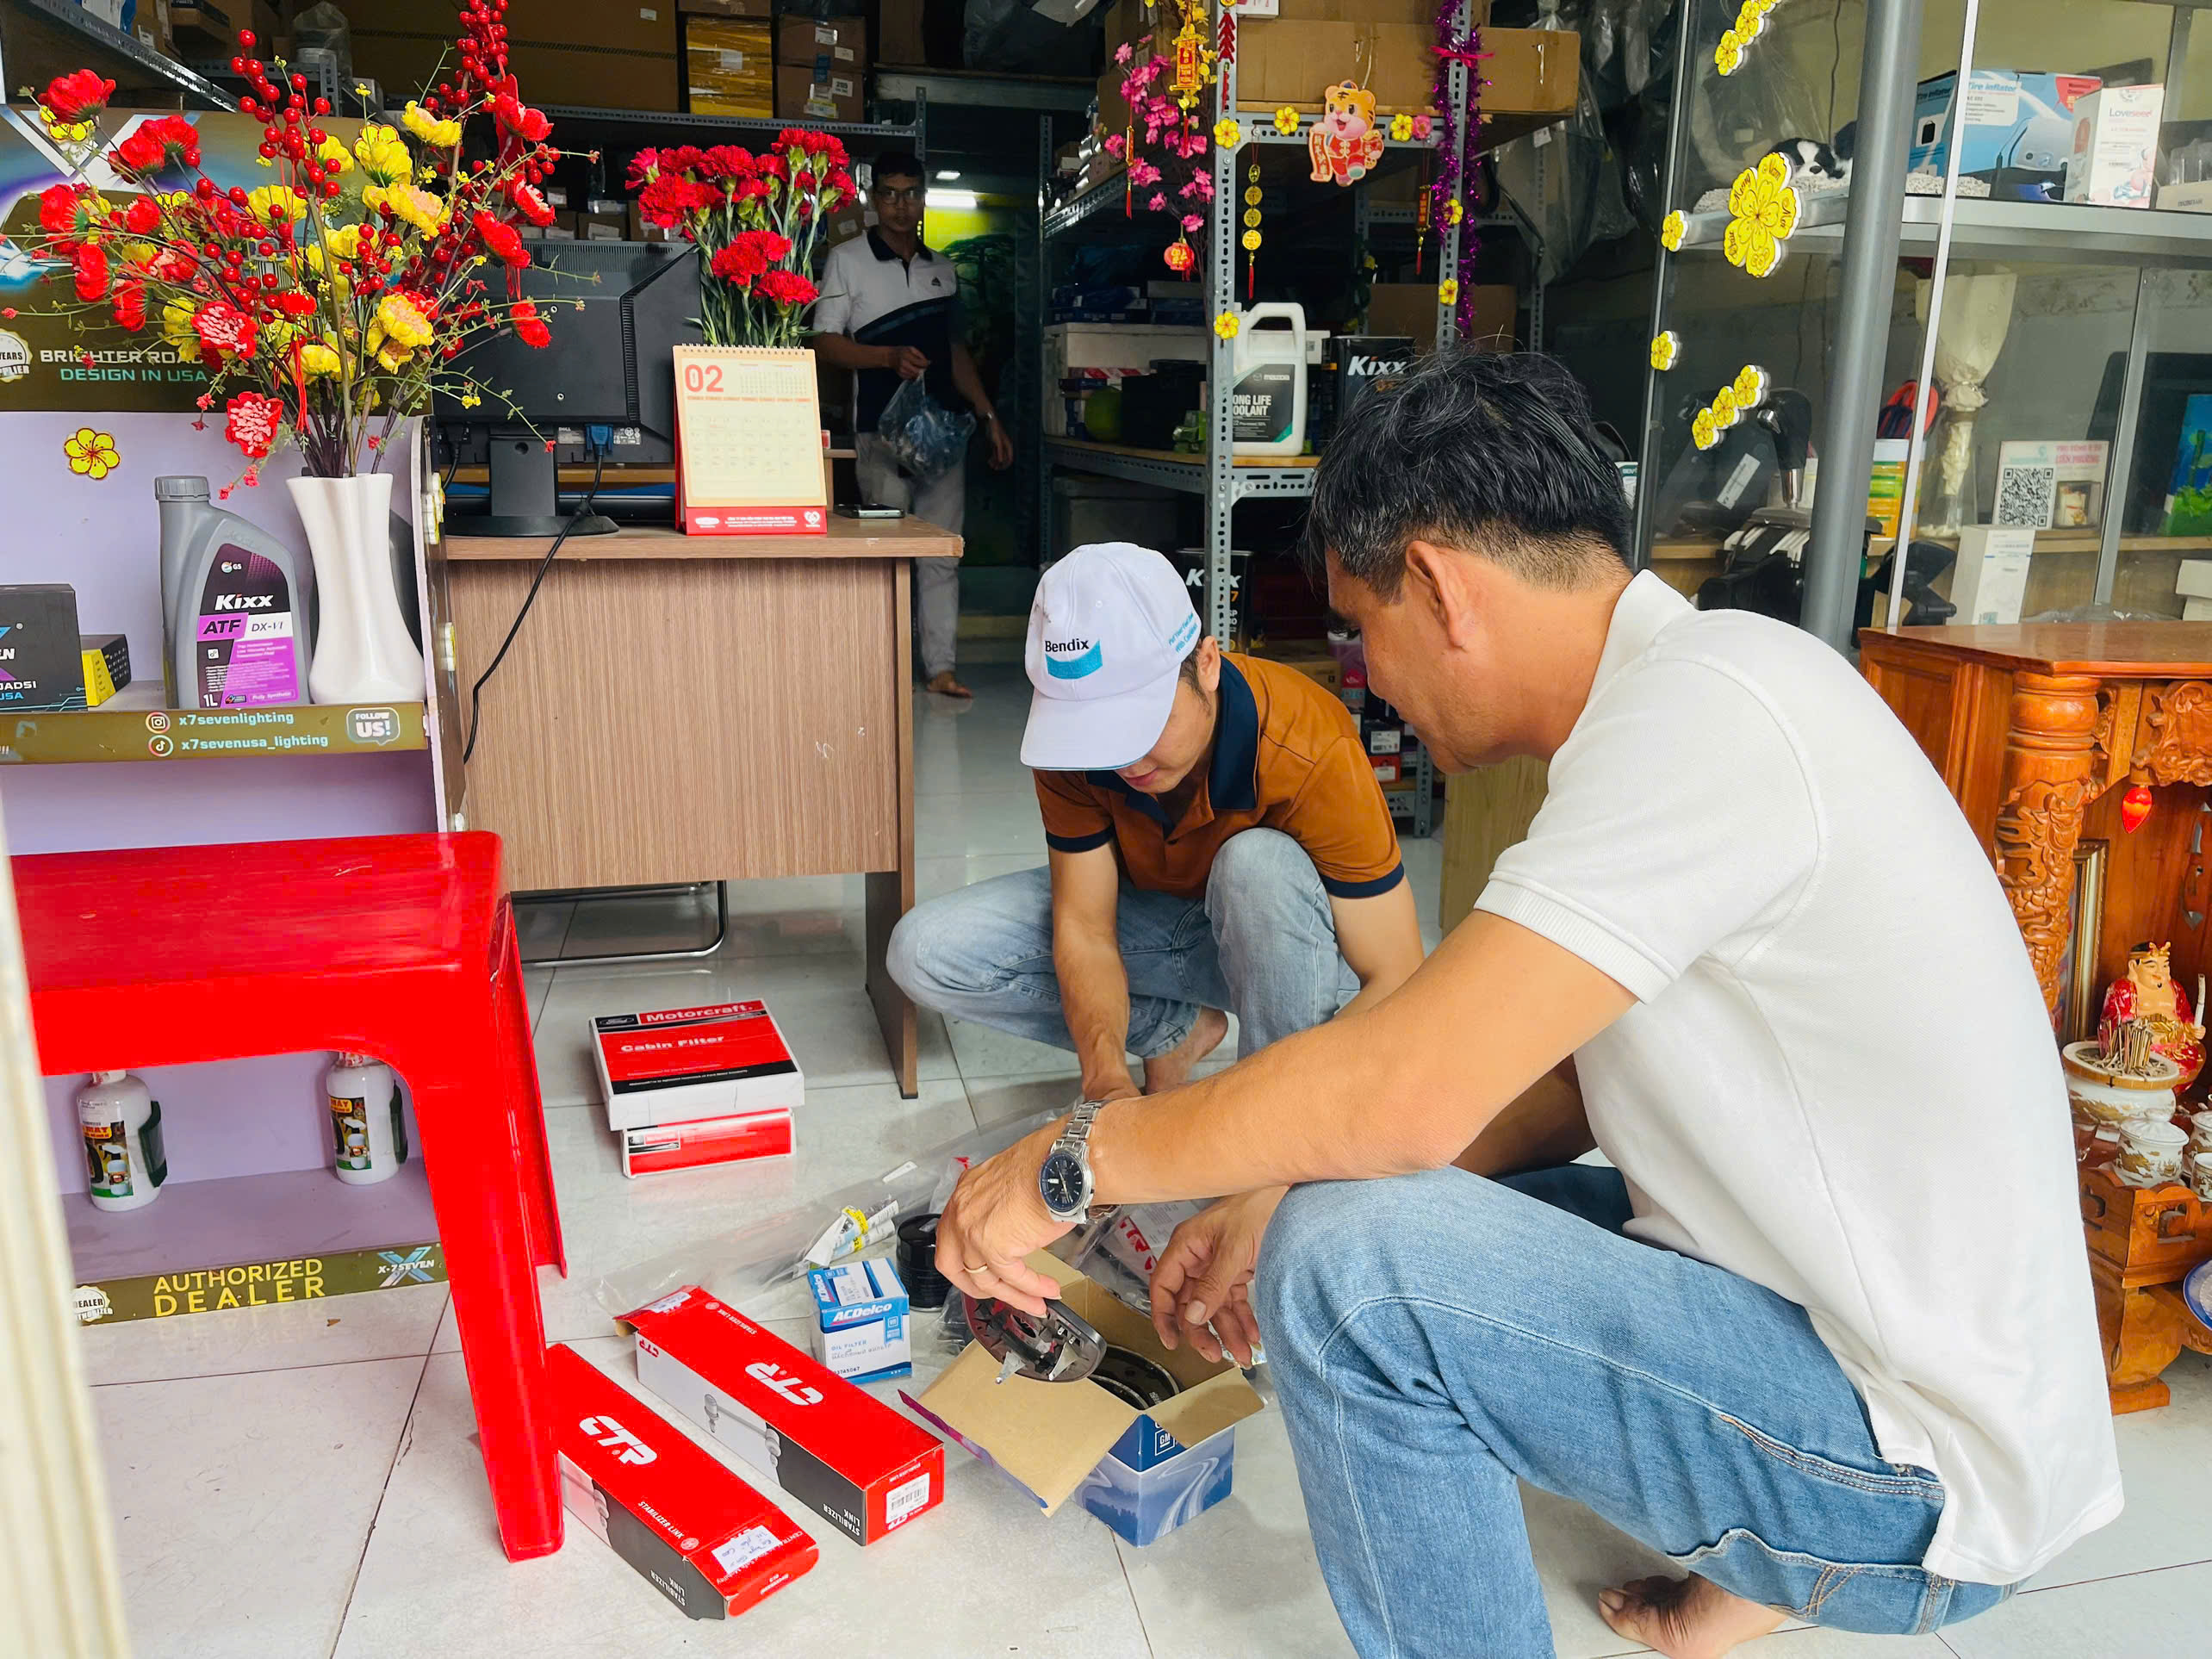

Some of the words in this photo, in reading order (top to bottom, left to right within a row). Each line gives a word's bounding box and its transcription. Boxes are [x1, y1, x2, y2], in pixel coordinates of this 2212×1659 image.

[40, 350, 142, 363] BRIHTER
[1347, 356, 1408, 376] Kixx
[59, 368, 136, 382] DESIGN
[141, 369, 162, 382] IN
[166, 370, 208, 382] USA
[684, 363, 724, 393] 02
[1233, 395, 1251, 406] ONG
[1252, 395, 1272, 406] LIFE
[1233, 405, 1269, 416] OOLANT
[214, 593, 274, 611] Kixx
[203, 618, 241, 635] ATF
[1045, 638, 1090, 653] Bendix
[203, 693, 218, 707] 1L
[178, 712, 295, 726] x7sevenlighting
[355, 720, 391, 737] US!
[181, 735, 329, 750] x7sevenusa_lighting
[621, 1041, 674, 1053] Cabin
[677, 1035, 724, 1047] Filter
[153, 1258, 323, 1295] AUTHORIZED
[154, 1277, 326, 1317] DEALER
[832, 1302, 892, 1322] ACDelco
[844, 1339, 867, 1349] FILTER
[1159, 1432, 1171, 1445] GM
[638, 1500, 671, 1528] STABILIZER
[668, 1525, 685, 1539] LINK
[823, 1503, 861, 1537] STABILIZER
[843, 1508, 861, 1525] LINK
[650, 1569, 687, 1606] STABILIZER
[668, 1577, 686, 1597] LINK
